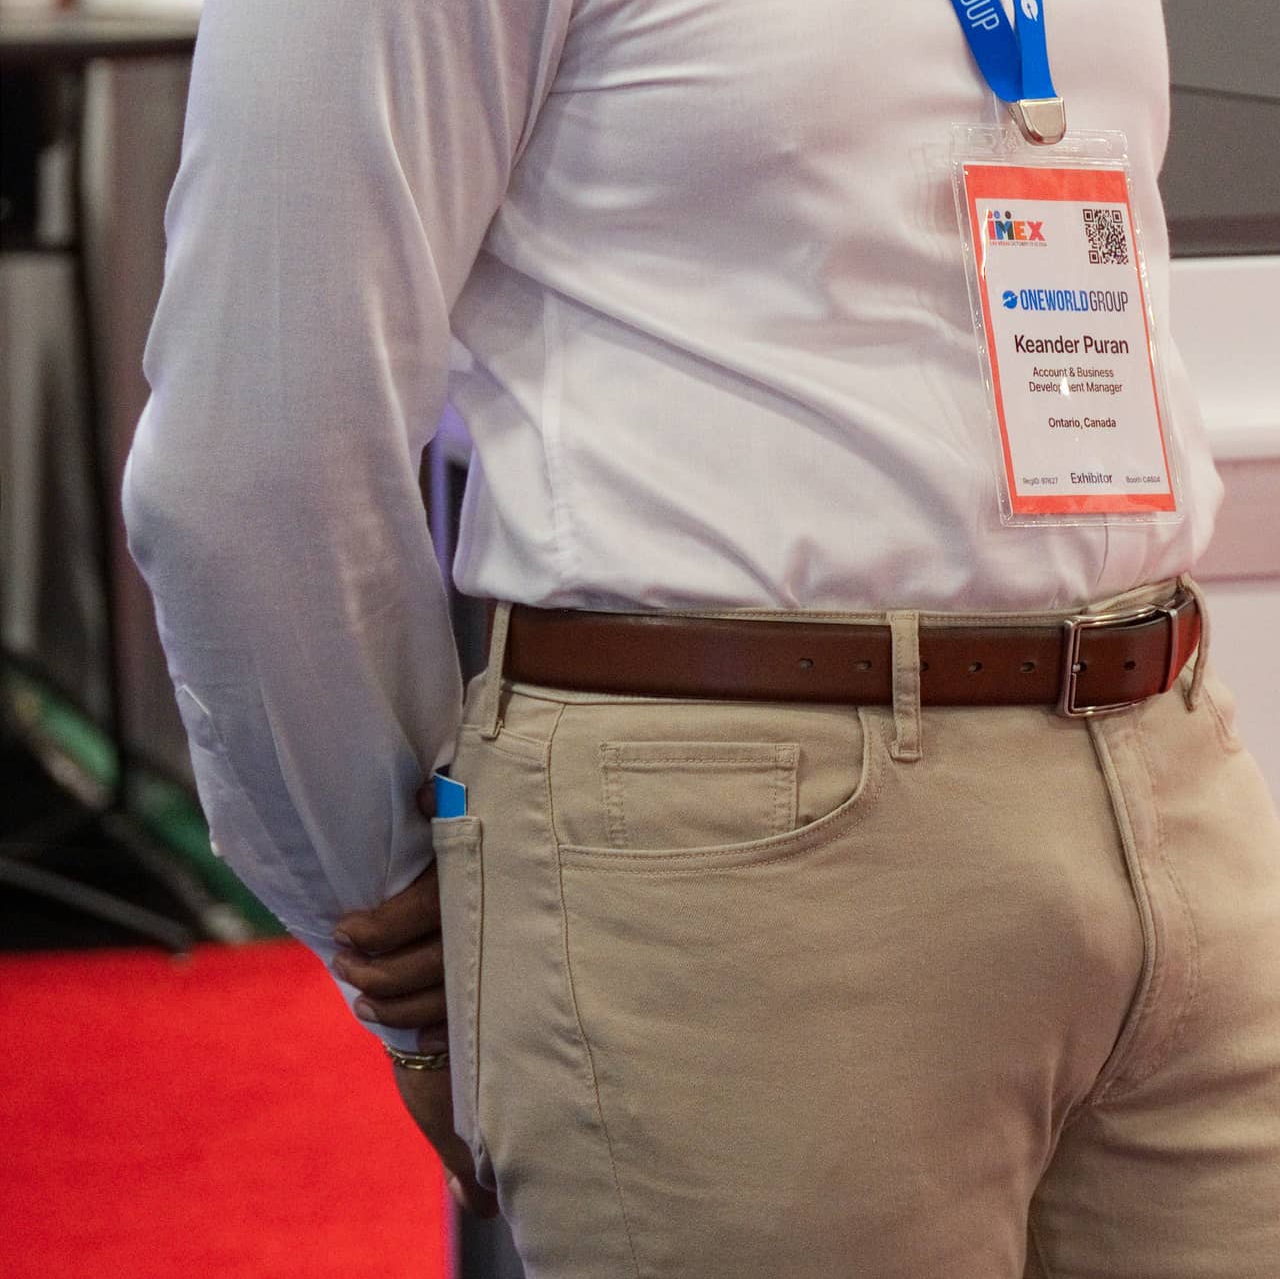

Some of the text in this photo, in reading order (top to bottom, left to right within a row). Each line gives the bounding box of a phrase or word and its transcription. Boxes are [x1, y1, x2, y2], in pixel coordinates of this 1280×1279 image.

[1014, 334, 1130, 354] Keander Puran
[1032, 367, 1114, 378] Account & Business
[1086, 382, 1123, 394] Manager
[1048, 417, 1117, 430] Ontario, Canada
[1070, 472, 1113, 484] Exhibitor
